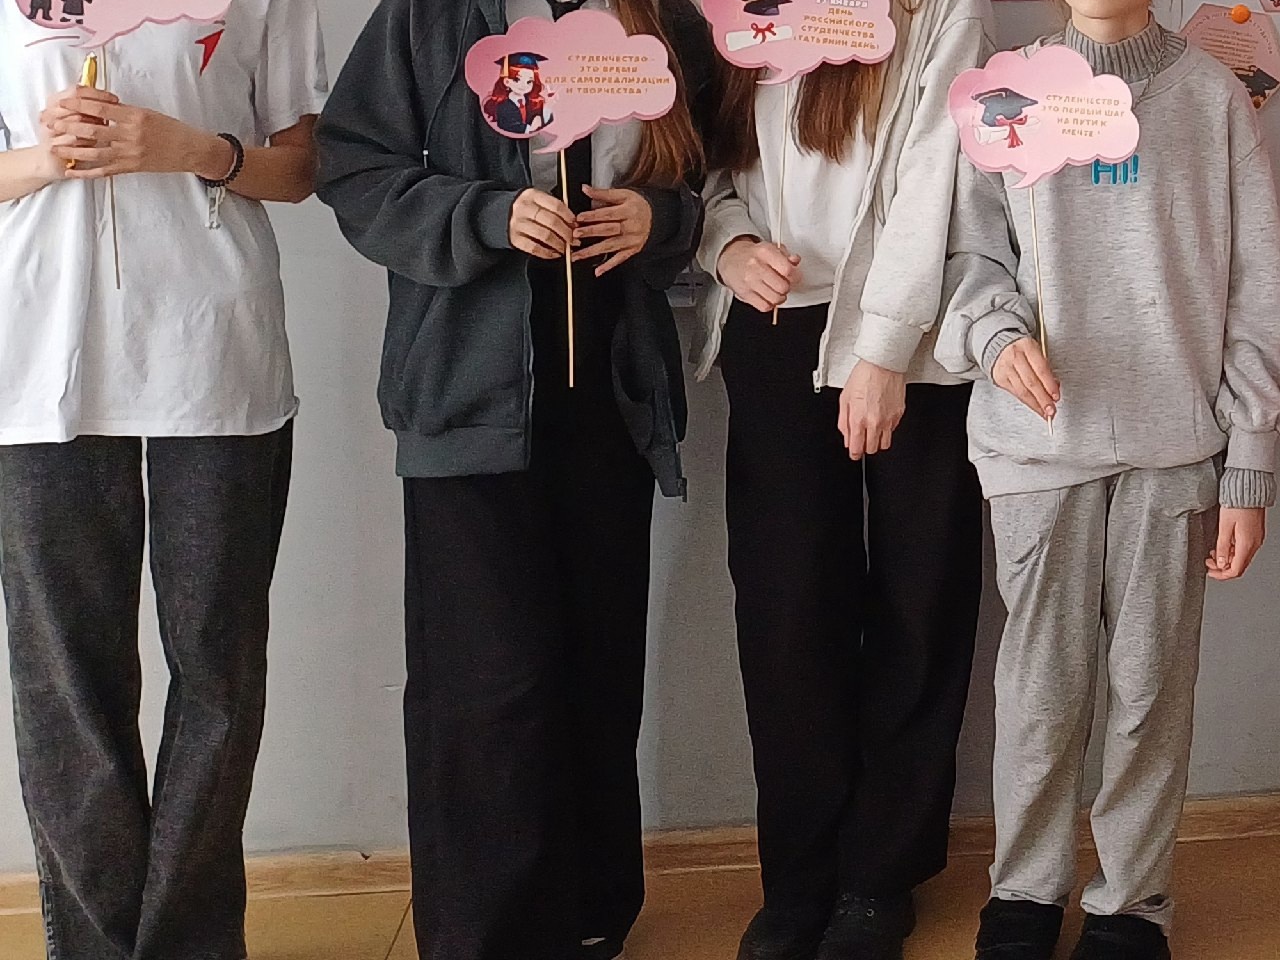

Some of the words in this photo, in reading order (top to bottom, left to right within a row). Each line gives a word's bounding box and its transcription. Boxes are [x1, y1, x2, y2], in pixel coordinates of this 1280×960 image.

[827, 7, 853, 16] ДЕНЬ
[801, 25, 875, 39] СТУДЕНЧЕСТВА
[567, 55, 649, 63] СТУДЕНЧЕСТВО
[544, 76, 567, 84] ДЛЯ
[1104, 109, 1125, 118] ШАГ
[1057, 117, 1070, 125] НА
[1072, 118, 1098, 126] ПУТИ
